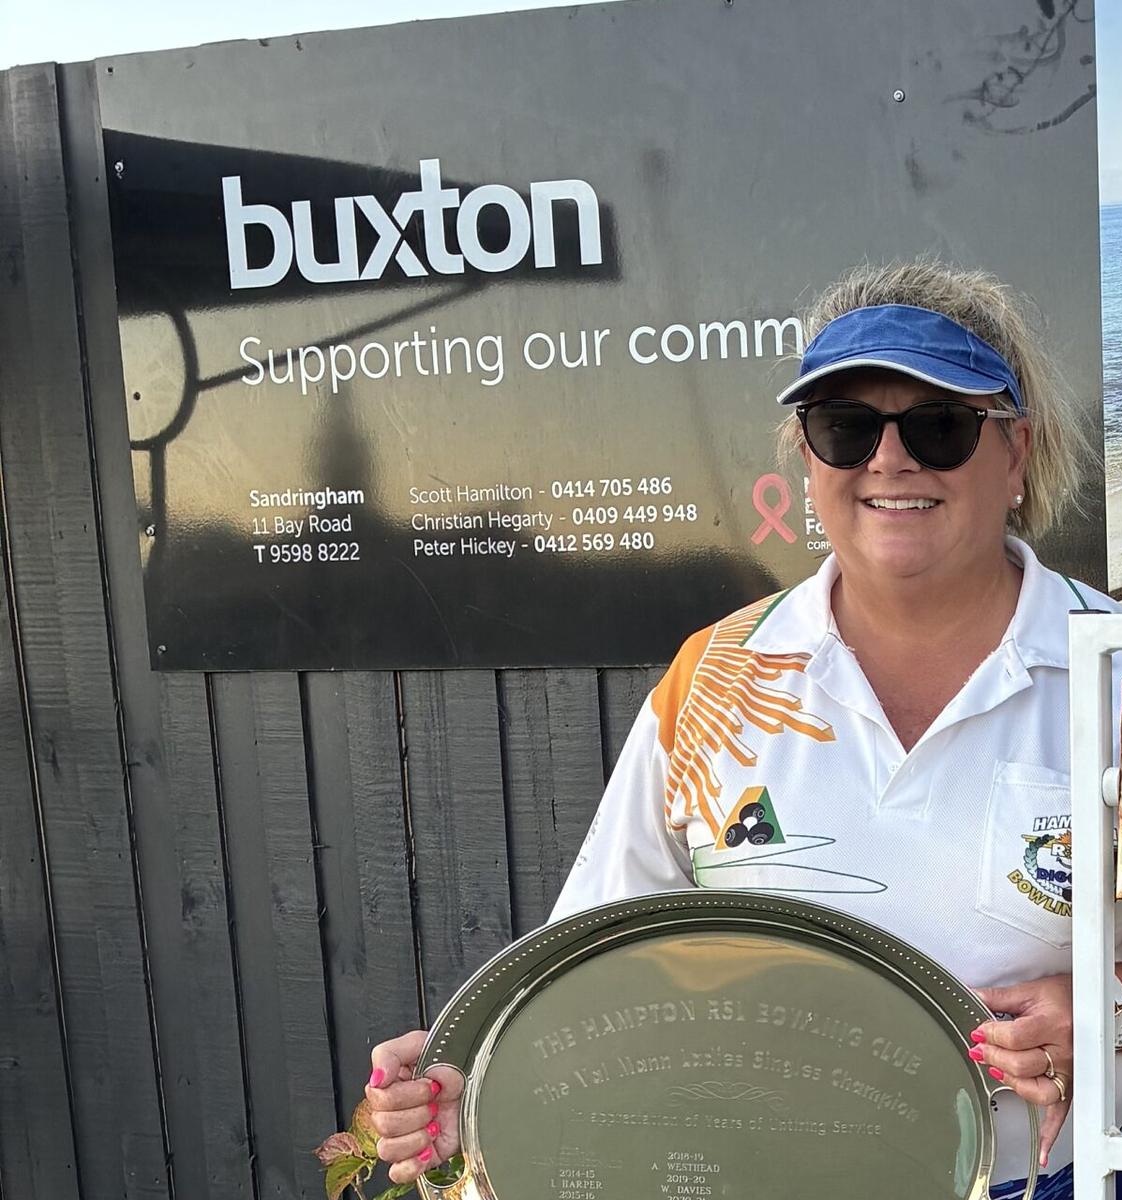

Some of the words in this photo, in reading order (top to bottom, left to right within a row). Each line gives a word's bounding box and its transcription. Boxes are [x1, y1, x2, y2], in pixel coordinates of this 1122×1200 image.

[222, 158, 602, 289] buxton
[240, 326, 503, 395] Supporting
[523, 328, 610, 370] our
[629, 316, 803, 364] comm
[249, 487, 365, 509] Sandringham
[409, 486, 452, 504] Scott
[457, 483, 533, 502] Hamilton
[551, 480, 596, 499] 0414
[600, 478, 633, 497] 705
[637, 477, 672, 495] 486
[252, 517, 270, 535] 11
[274, 516, 303, 538] Bay
[308, 514, 352, 533] Road
[411, 512, 483, 531] Christian
[488, 509, 553, 532] Hegarty
[572, 506, 618, 526] 0409
[622, 505, 657, 523] 449
[662, 504, 698, 522] 948
[253, 545, 266, 563] T
[271, 544, 313, 563] 9598
[318, 542, 360, 562] 8222
[413, 539, 454, 556] Peter
[460, 536, 516, 558] Hickey
[534, 534, 577, 553] 0412
[582, 533, 614, 552] 569
[619, 532, 654, 550] 480
[562, 1180, 603, 1189] HARPER
[666, 1174, 706, 1184] 2019-20
[677, 1185, 712, 1195] DAVIES
